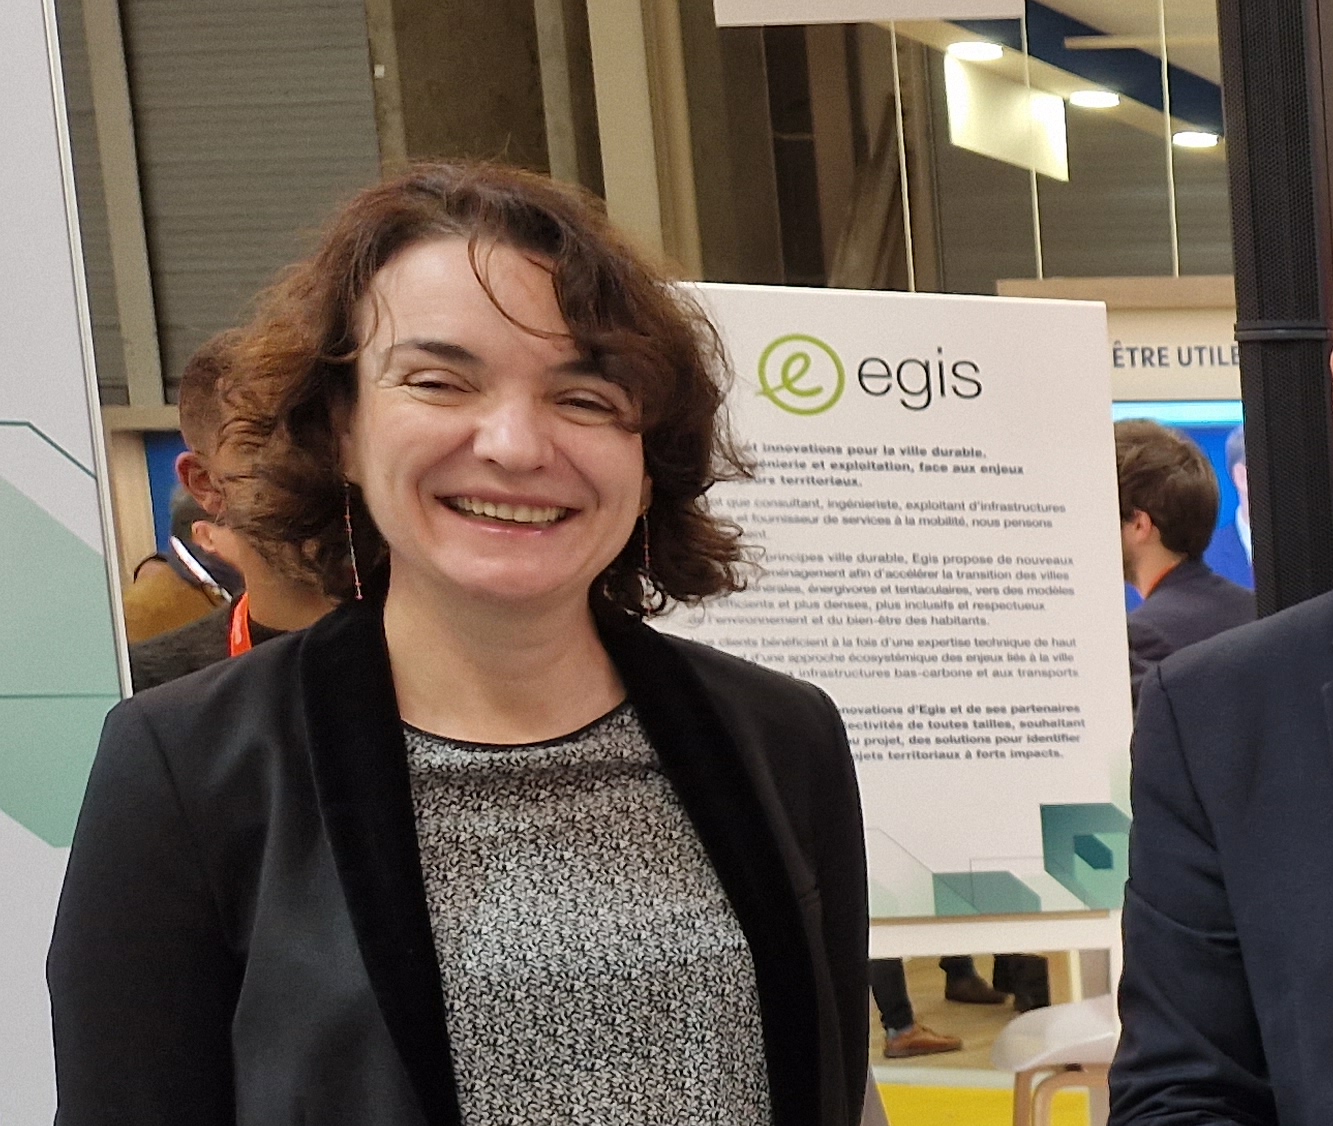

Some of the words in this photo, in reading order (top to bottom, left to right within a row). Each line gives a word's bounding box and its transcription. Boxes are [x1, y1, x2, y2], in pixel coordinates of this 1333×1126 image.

[1113, 341, 1170, 368] ÊTRE
[857, 346, 983, 411] egis
[763, 443, 842, 456] innovations
[847, 446, 877, 458] pour
[883, 445, 895, 456] la
[900, 446, 927, 457] ville
[919, 462, 948, 473] face
[953, 465, 975, 474] aux
[980, 463, 1024, 476] enjeux
[912, 552, 938, 565] Egis
